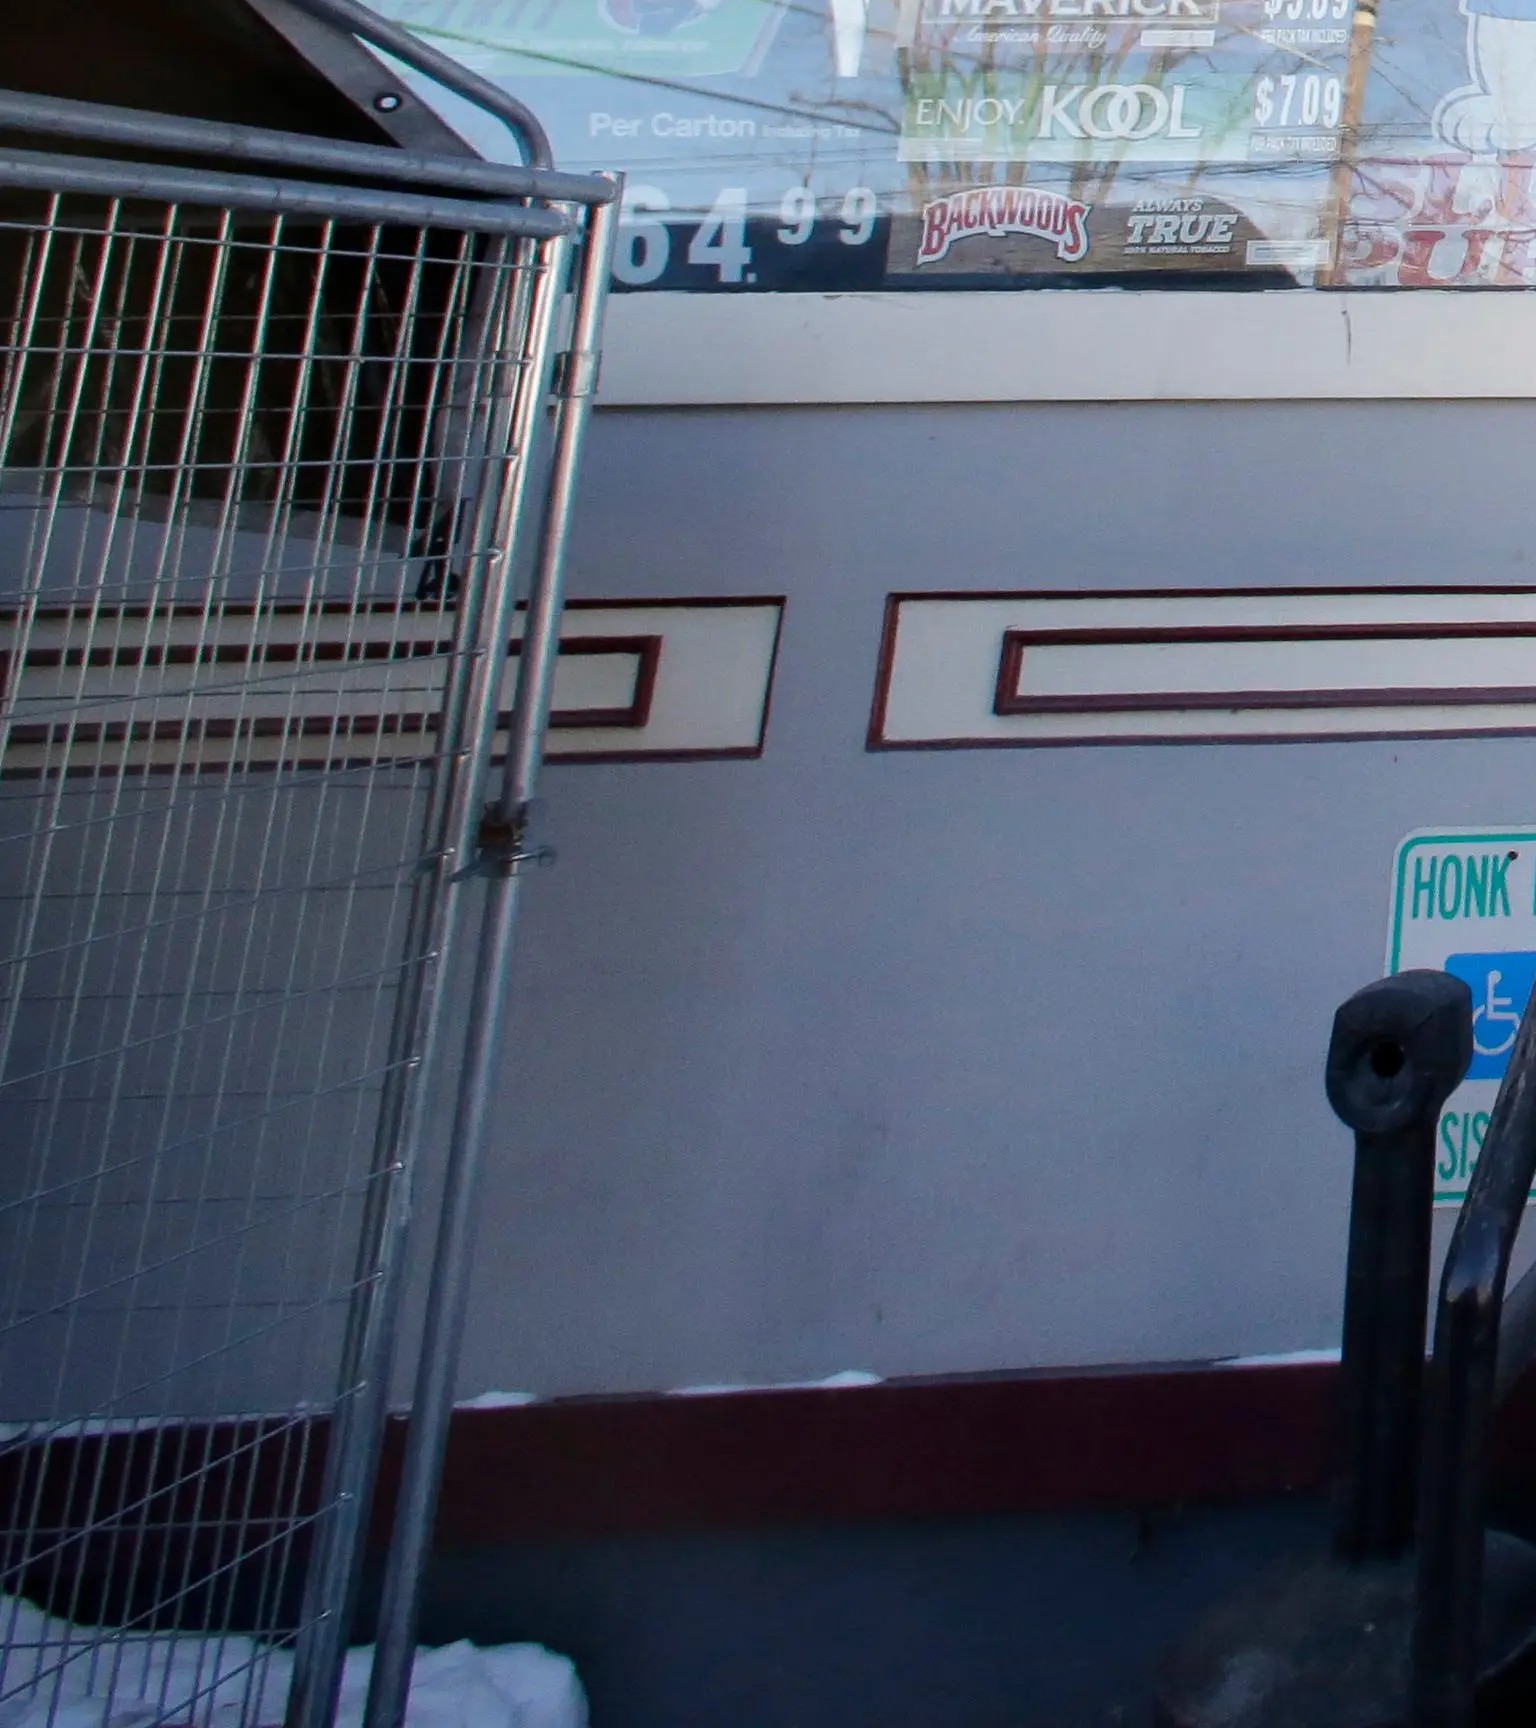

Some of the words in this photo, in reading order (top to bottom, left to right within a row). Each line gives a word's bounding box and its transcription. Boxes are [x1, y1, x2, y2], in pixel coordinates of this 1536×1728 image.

[589, 112, 642, 138] Per
[651, 112, 756, 138] Carton
[915, 98, 1025, 133] ENJOY.
[1037, 83, 1202, 140] KOOL
[919, 187, 1090, 260] BACKWOODS
[1132, 198, 1204, 213] ALWAYS
[1125, 213, 1240, 244] TRUE
[1411, 853, 1512, 920] HONK
